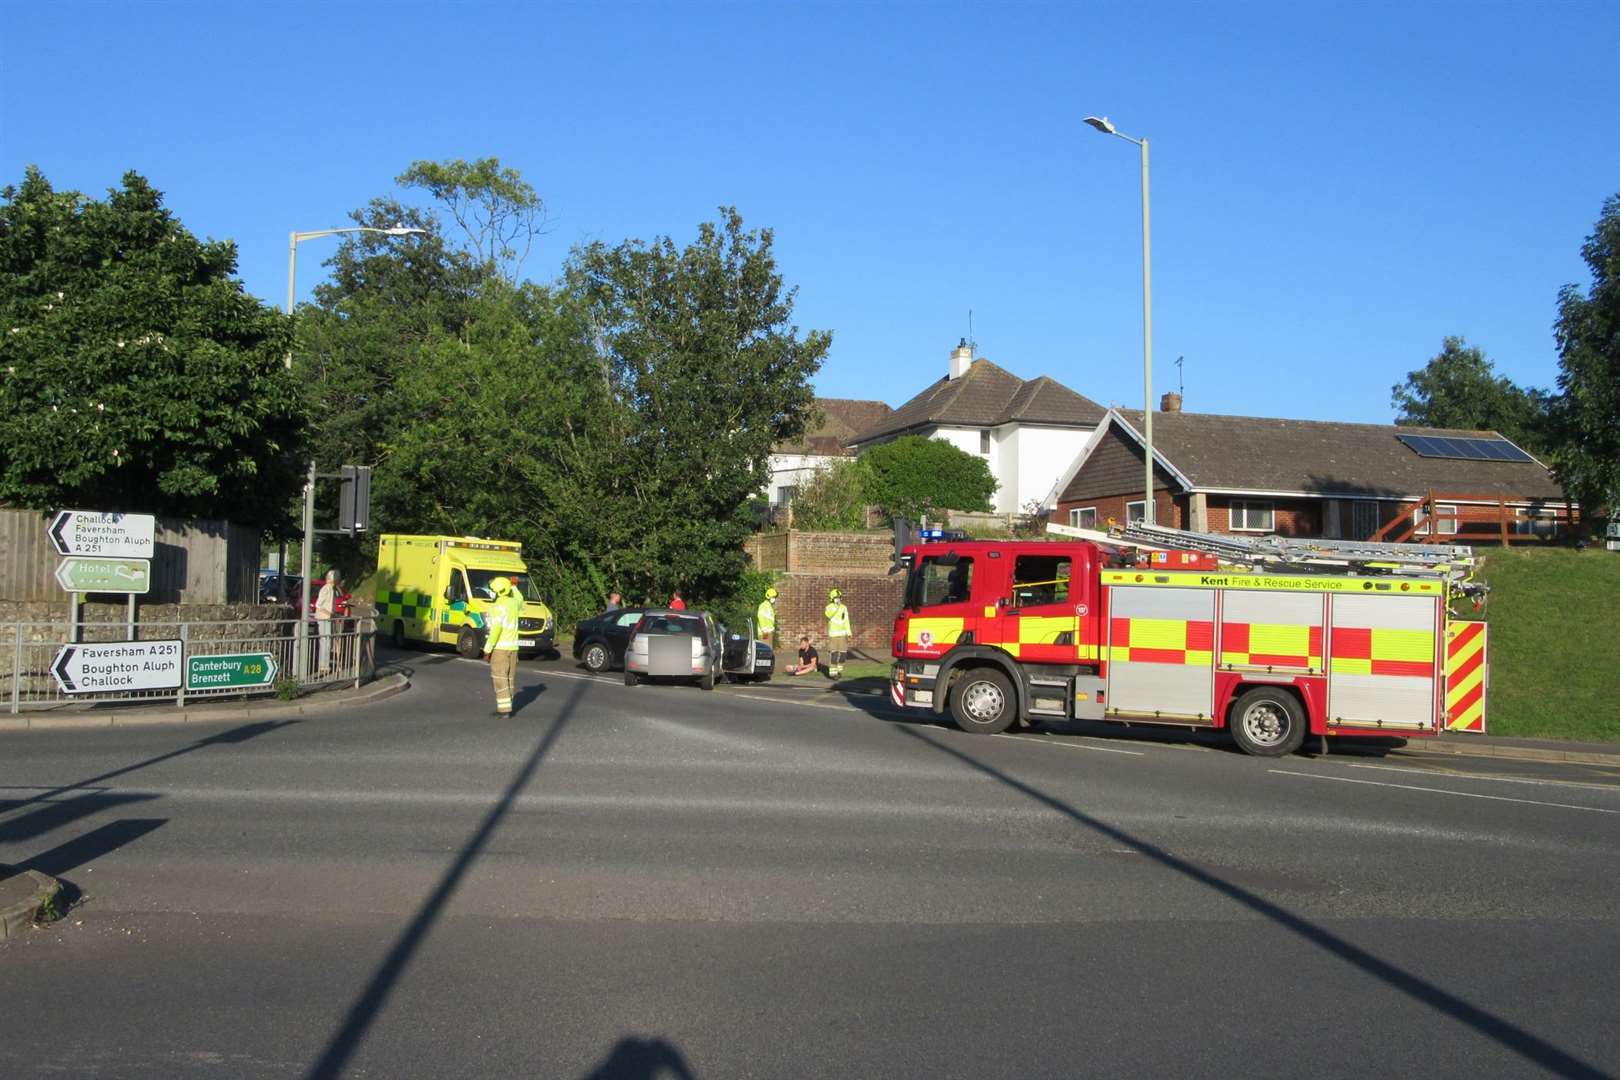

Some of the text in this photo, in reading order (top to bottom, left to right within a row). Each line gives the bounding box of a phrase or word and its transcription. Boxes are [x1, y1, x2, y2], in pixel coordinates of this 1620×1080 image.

[76, 524, 126, 534] Faversham
[76, 534, 120, 544] Boughton
[80, 564, 110, 574] Hotel
[1201, 576, 1342, 589] Kent Fire & Rescue Service
[82, 648, 145, 657] Faversham
[82, 661, 175, 674] Boughton Aluph
[192, 660, 242, 671] Canterbury
[82, 676, 133, 686] Challock
[192, 673, 230, 683] Brenzett
